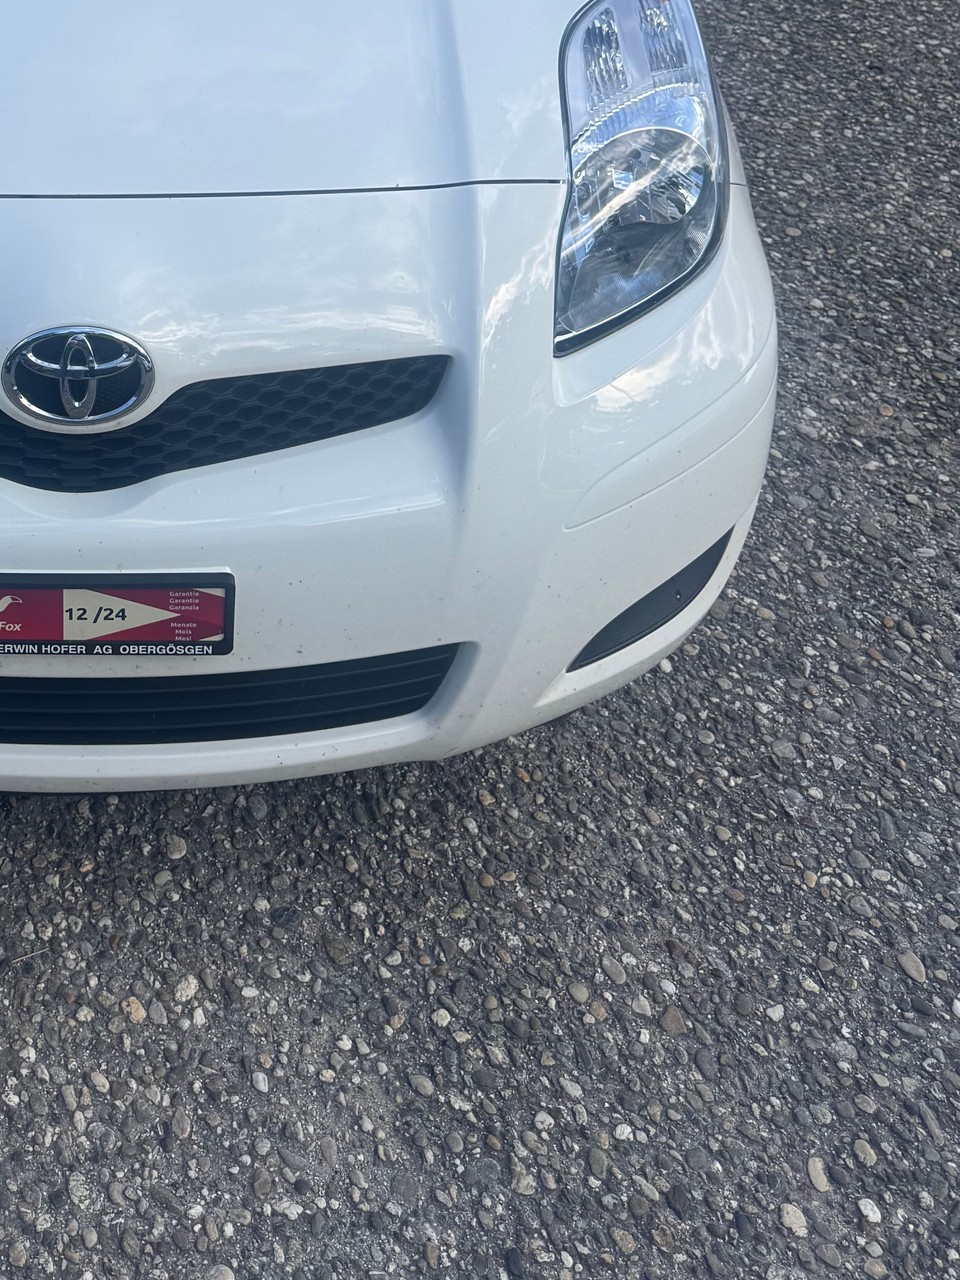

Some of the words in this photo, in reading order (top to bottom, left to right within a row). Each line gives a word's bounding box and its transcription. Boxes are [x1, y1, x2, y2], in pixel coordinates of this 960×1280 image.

[41, 644, 86, 654] HOFER
[93, 645, 113, 654] AG
[120, 643, 213, 655] OBERGÖSGEN
